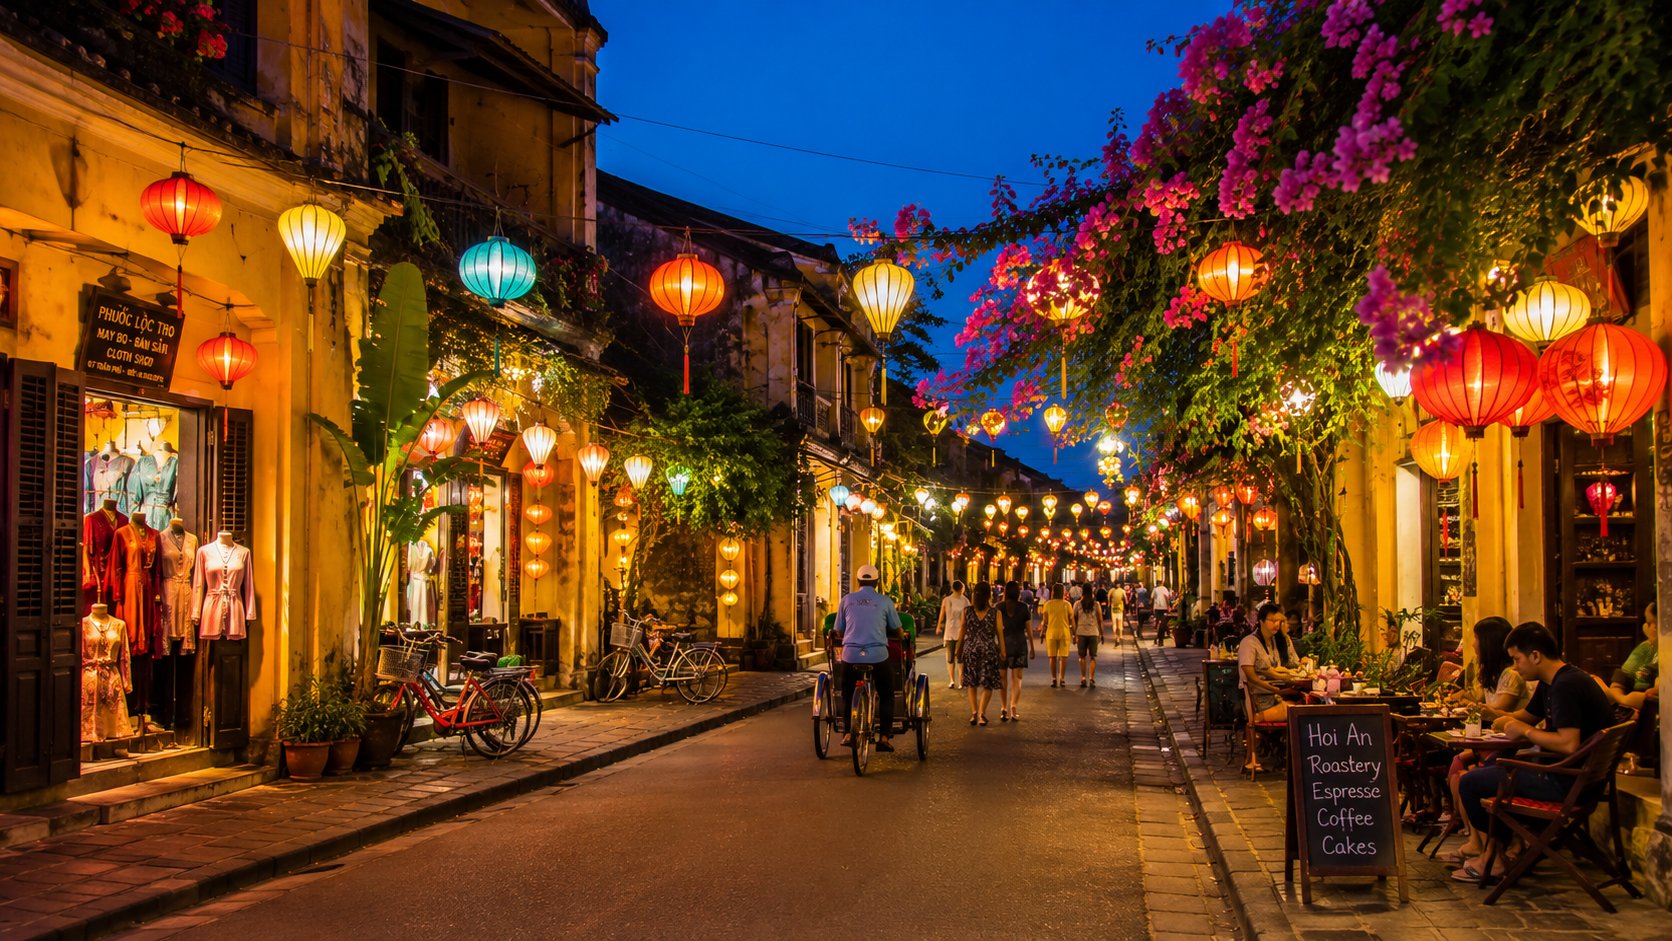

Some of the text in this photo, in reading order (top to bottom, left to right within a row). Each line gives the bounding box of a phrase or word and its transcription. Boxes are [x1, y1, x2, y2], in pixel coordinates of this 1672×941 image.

[1308, 722, 1373, 748] Hoi An
[1306, 754, 1382, 783] Roastery
[1317, 807, 1374, 832] Coffee
[1322, 835, 1377, 856] Cakes
